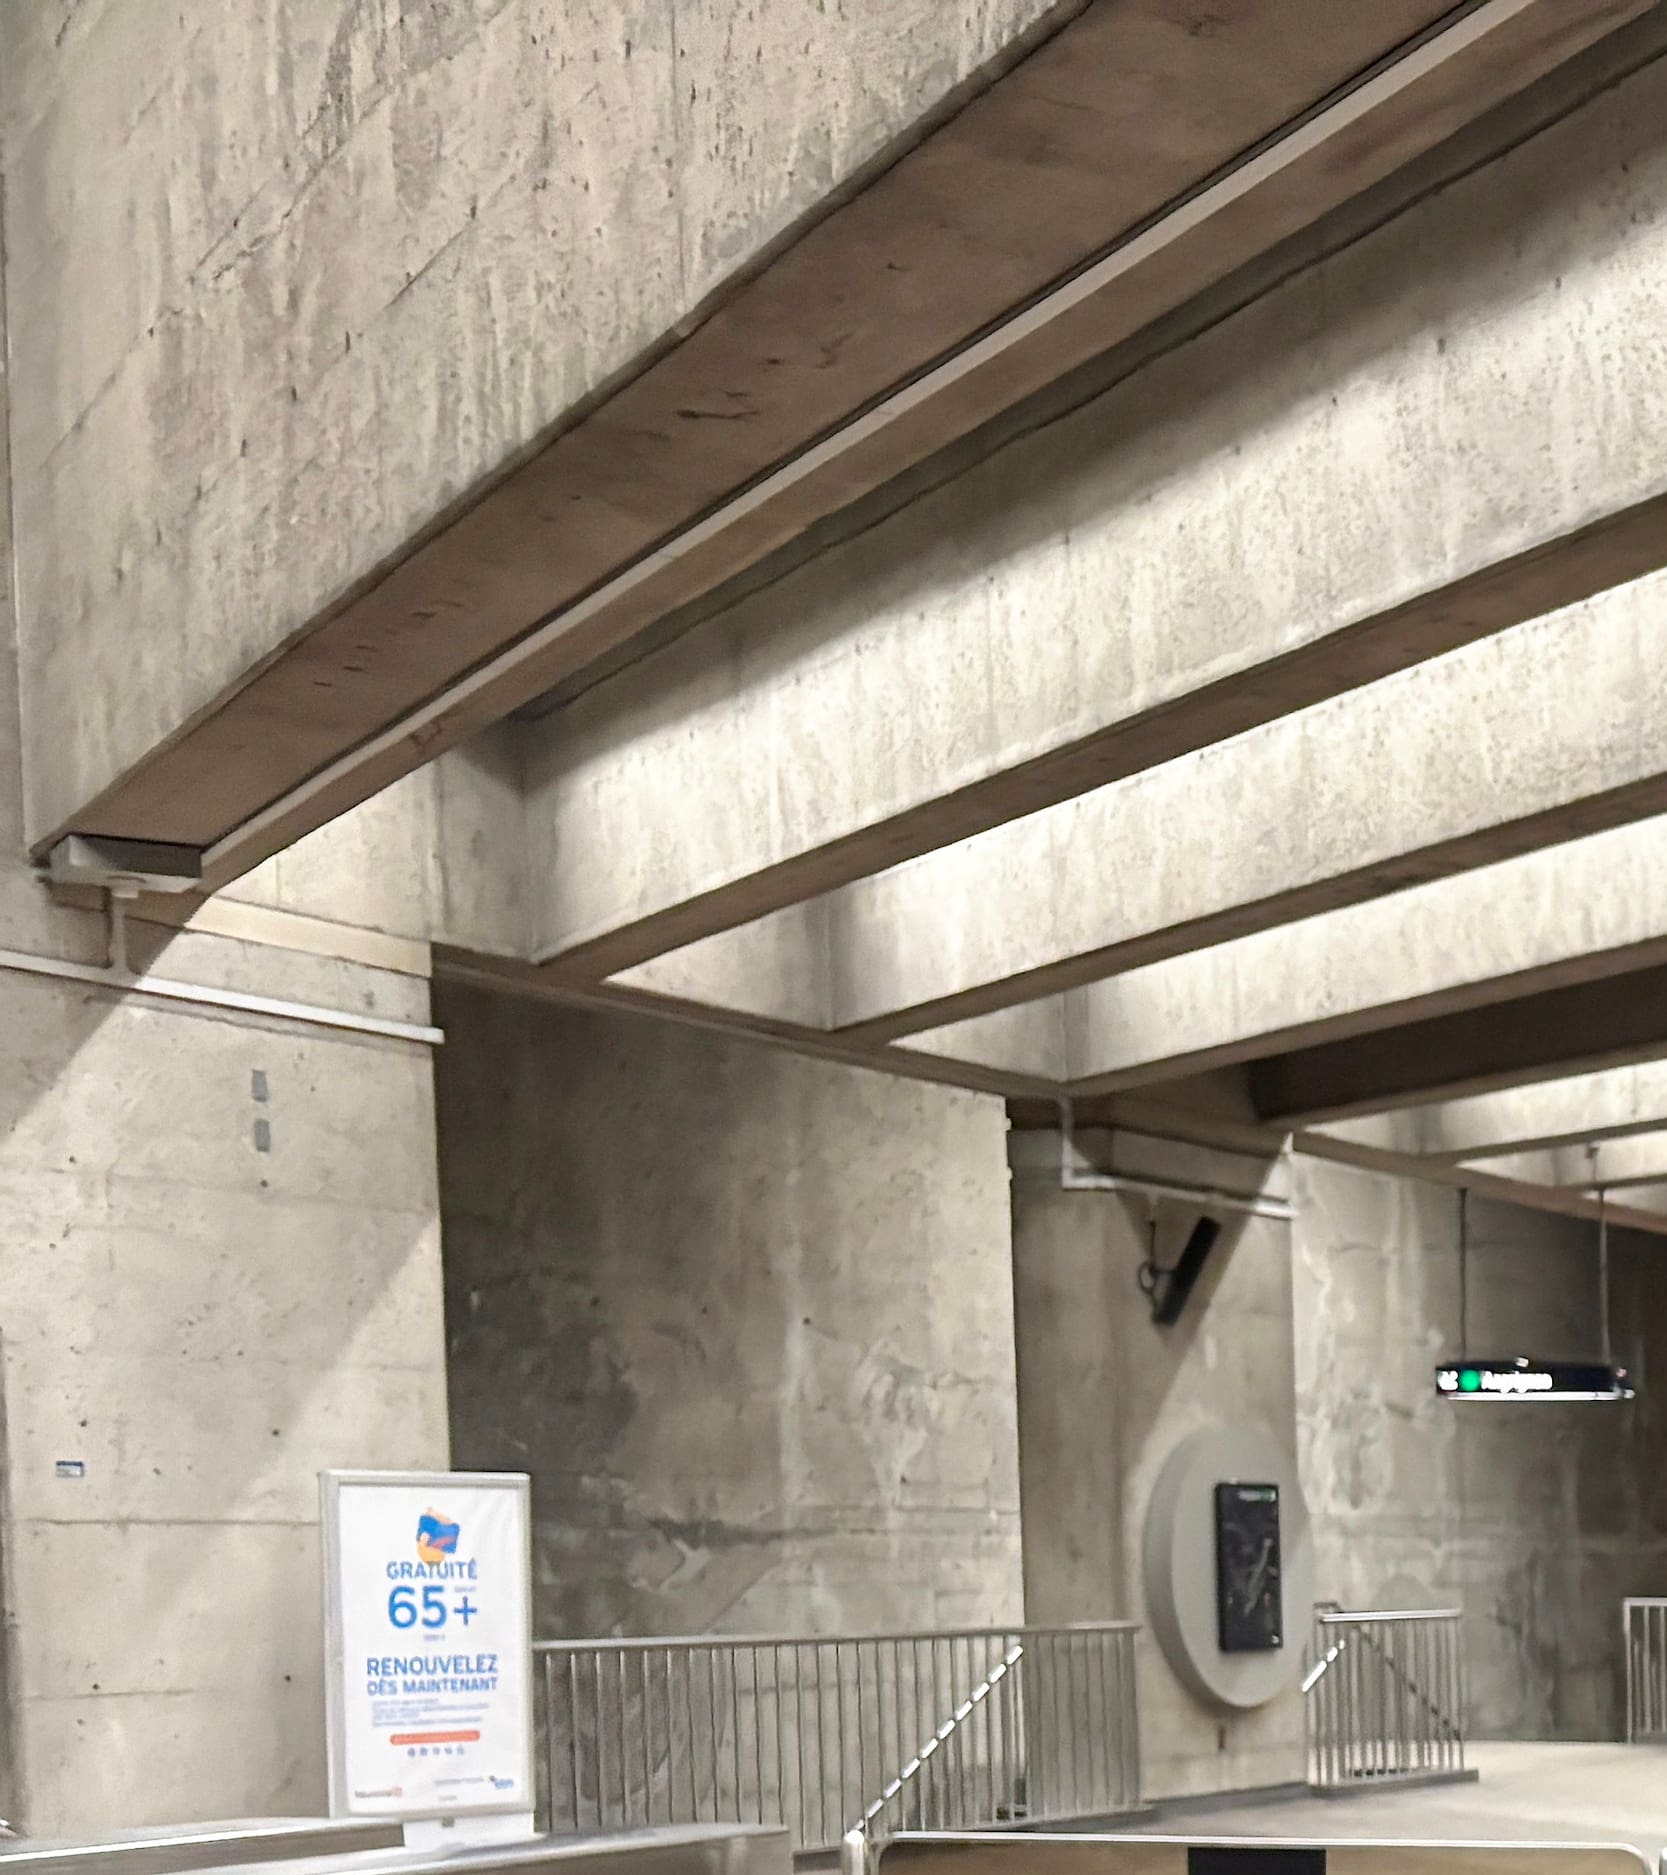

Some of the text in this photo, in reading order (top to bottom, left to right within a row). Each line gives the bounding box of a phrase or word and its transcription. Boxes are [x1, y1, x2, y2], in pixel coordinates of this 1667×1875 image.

[386, 1557, 478, 1580] GRATUITÉ
[387, 1585, 478, 1628] 65+
[366, 1653, 499, 1677] RENOUVELEZ
[402, 1676, 498, 1694] MAINTENANT
